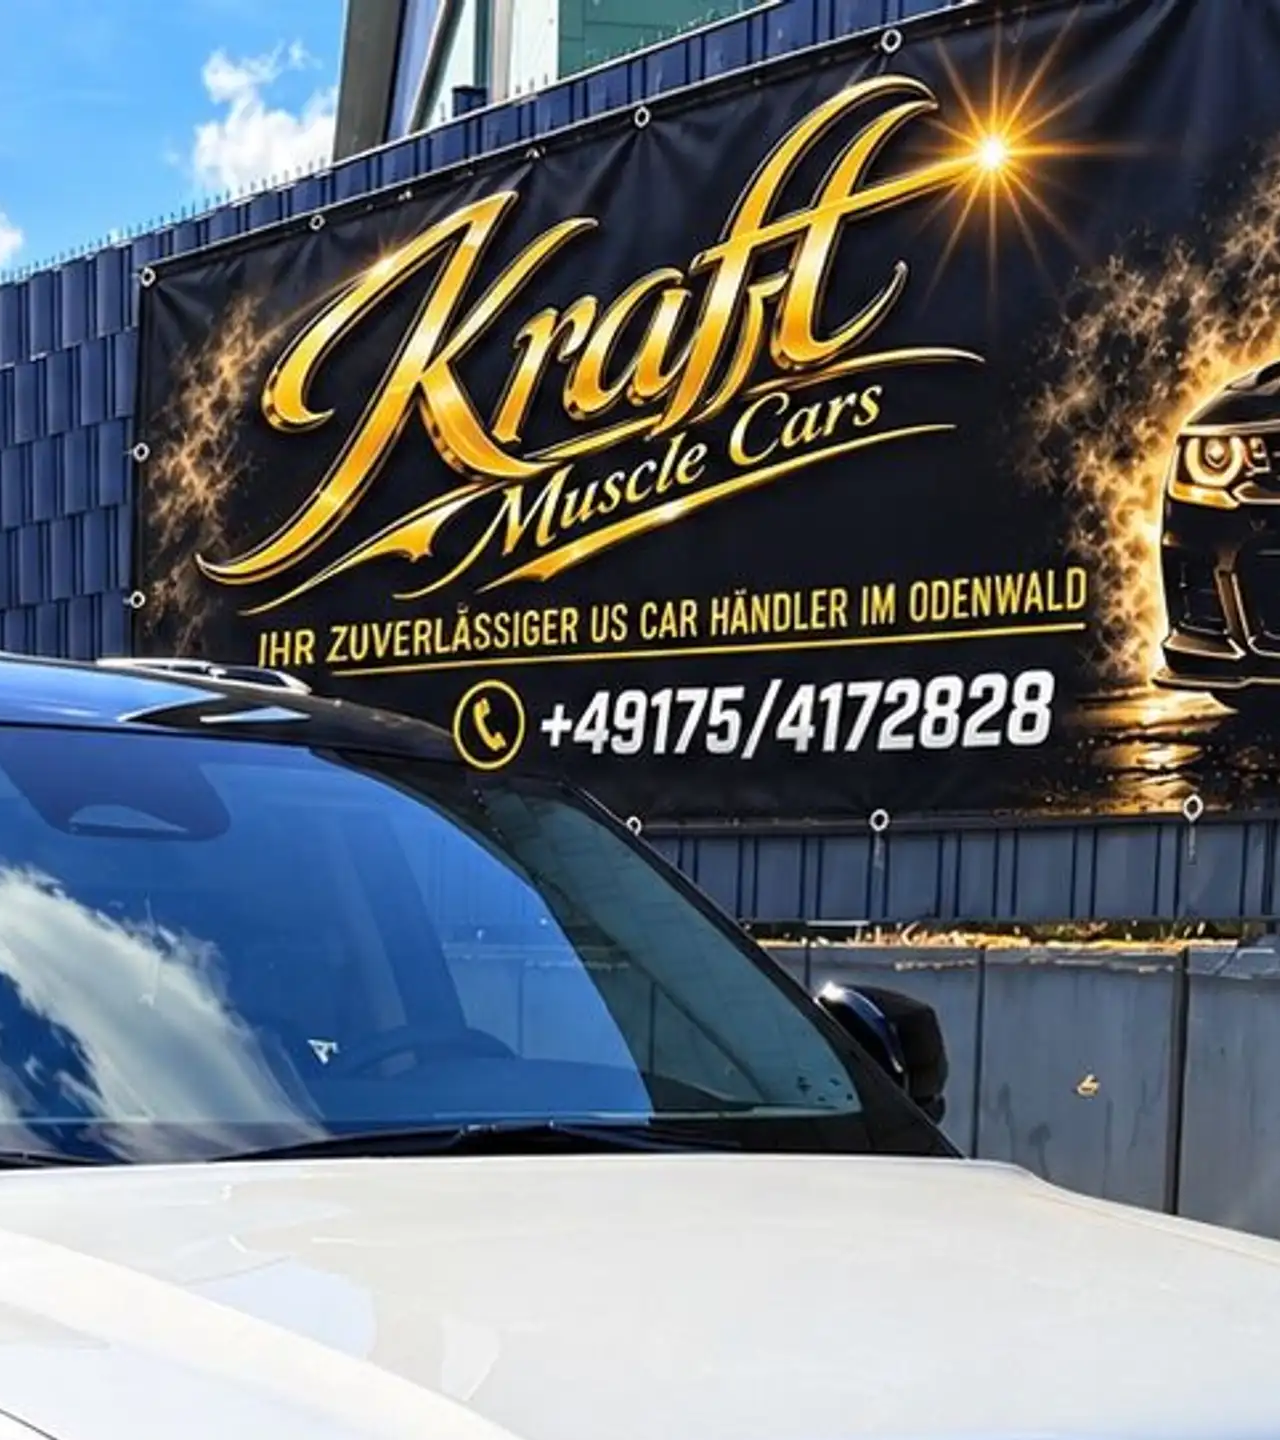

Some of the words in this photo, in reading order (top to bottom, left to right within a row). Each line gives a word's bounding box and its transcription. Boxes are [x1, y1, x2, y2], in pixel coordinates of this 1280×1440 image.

[196, 74, 960, 586] Kraft
[498, 430, 708, 556] Muscle
[728, 383, 884, 466] Cars
[257, 628, 316, 668] IHR
[325, 603, 579, 664] ZUVERLÄSSIGER
[590, 602, 629, 644] US
[639, 597, 698, 640] CAR
[710, 588, 849, 637] HÄNDLER
[860, 582, 897, 626] IM
[909, 566, 1089, 622] ODENWALD
[540, 669, 1056, 760] +49175/4172828
